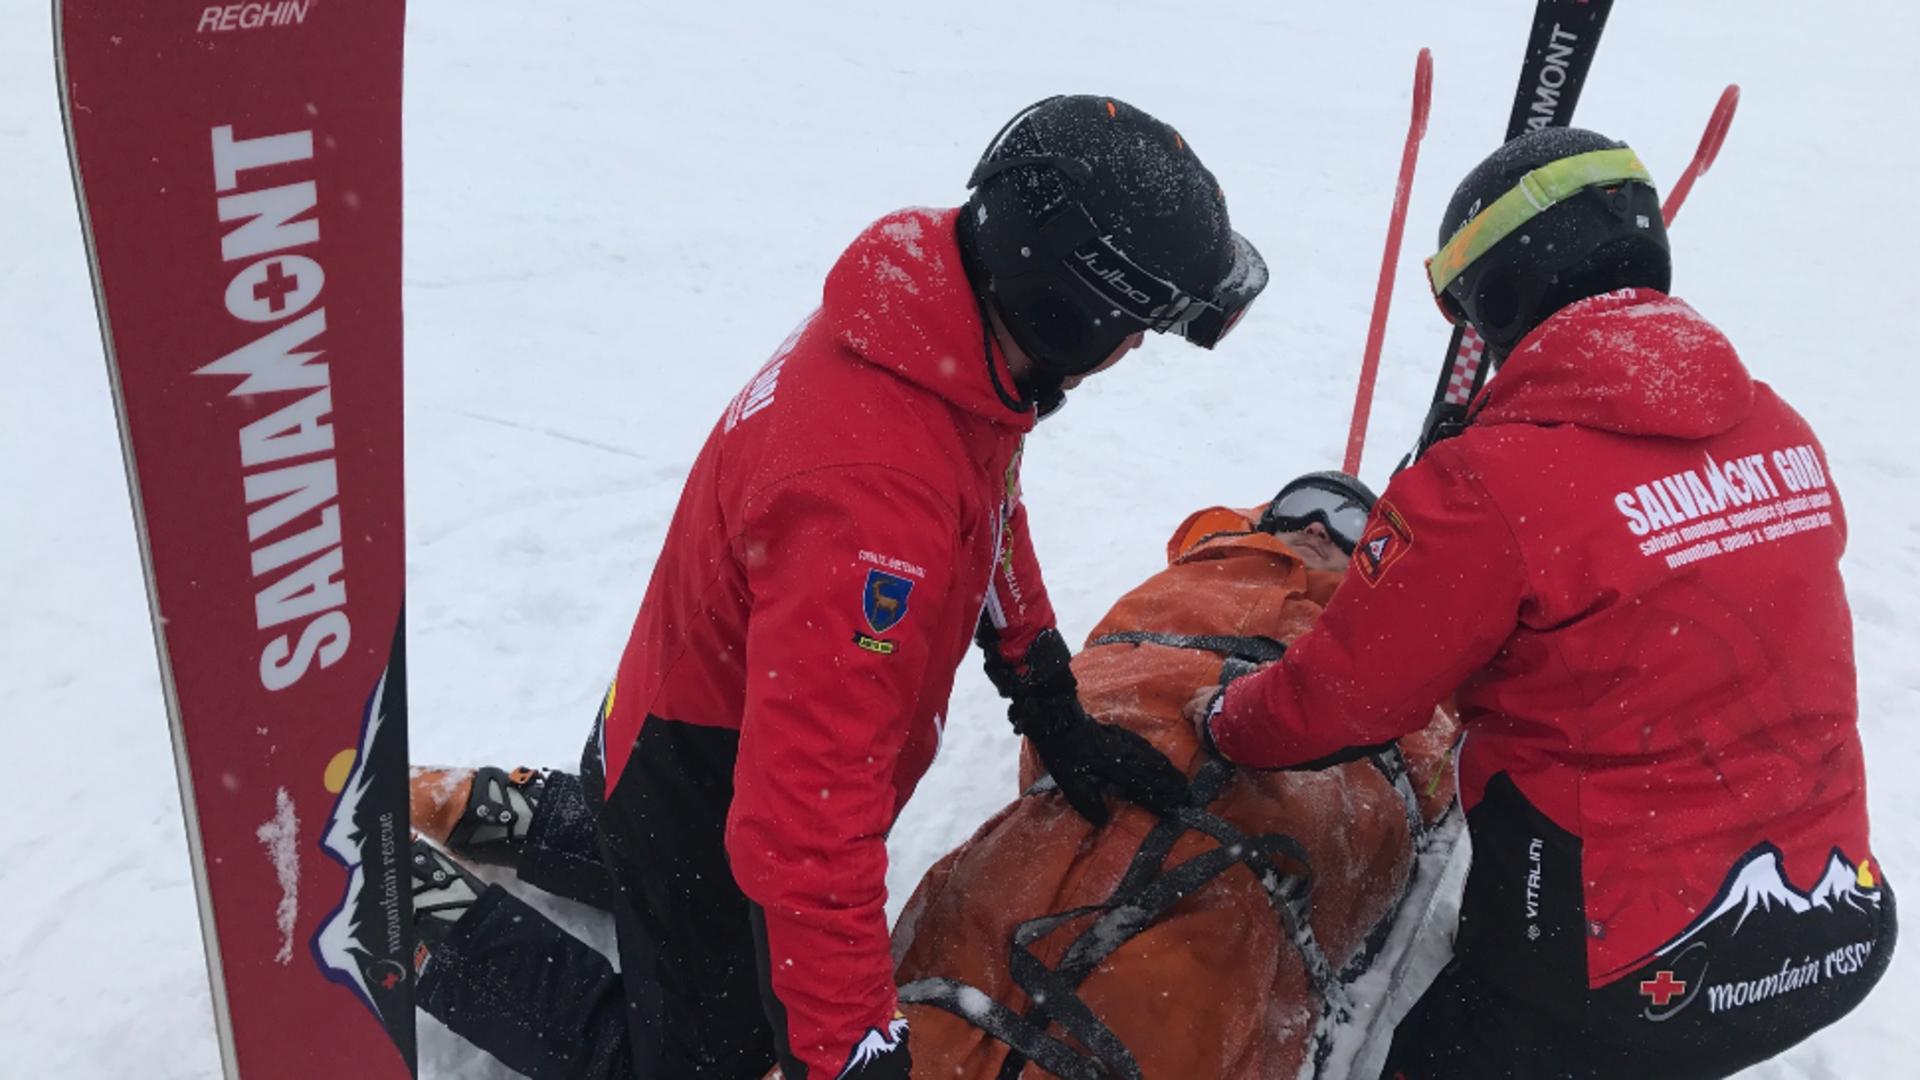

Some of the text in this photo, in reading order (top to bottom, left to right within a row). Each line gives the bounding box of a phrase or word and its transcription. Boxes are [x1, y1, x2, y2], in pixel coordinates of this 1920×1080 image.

[197, 0, 310, 32] REGHIN
[1524, 22, 1578, 134] AMONT
[1074, 249, 1151, 305] Julbo
[190, 125, 351, 691] SALVAMONT
[1615, 450, 1778, 535] SALVAMONT
[1525, 838, 1543, 918] VITALINI
[1708, 941, 1877, 1013] mountain resc
